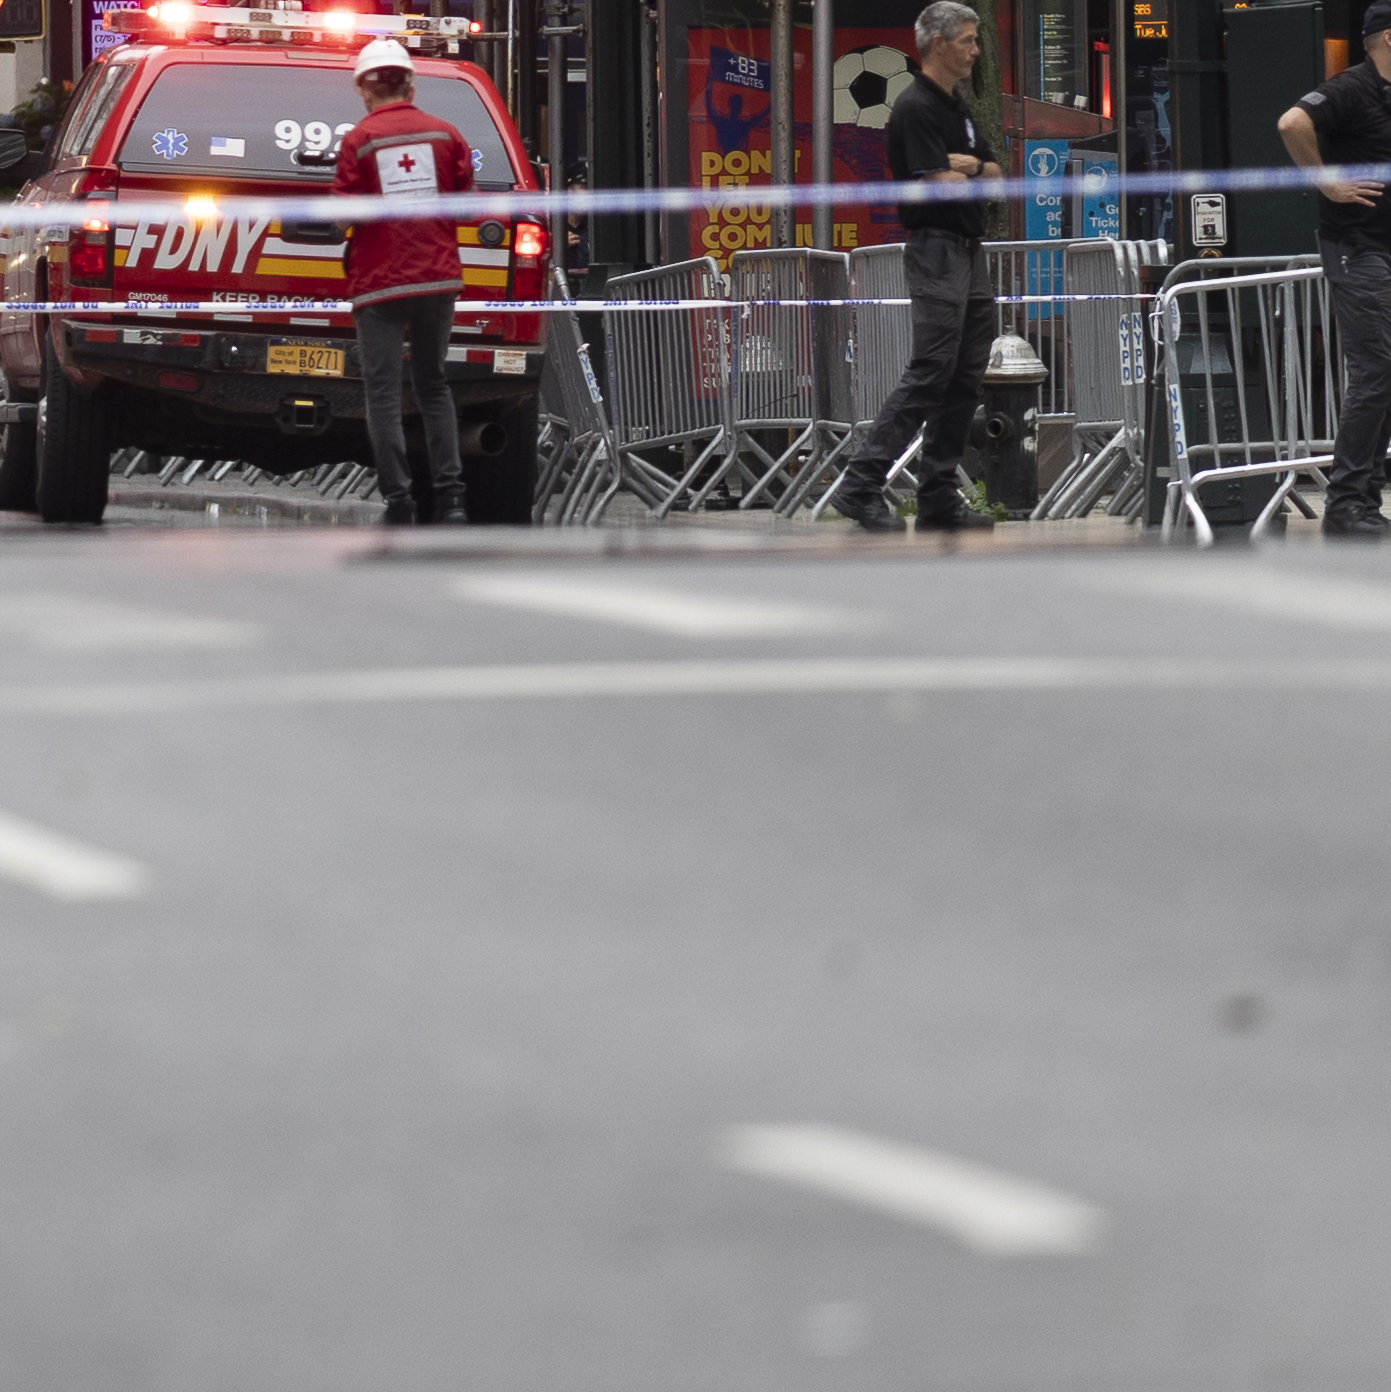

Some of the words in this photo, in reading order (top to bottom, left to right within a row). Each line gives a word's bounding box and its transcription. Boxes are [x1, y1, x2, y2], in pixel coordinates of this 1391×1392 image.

[93, 0, 140, 14] WATC
[728, 55, 759, 77] +83
[725, 70, 764, 89] MINUTES
[124, 211, 273, 274] FDNY
[212, 291, 259, 306] KEEP
[1119, 318, 1132, 381] NYPD
[1133, 314, 1144, 380] NYPD
[307, 350, 338, 369] 6271
[1169, 388, 1184, 456] NYPD
